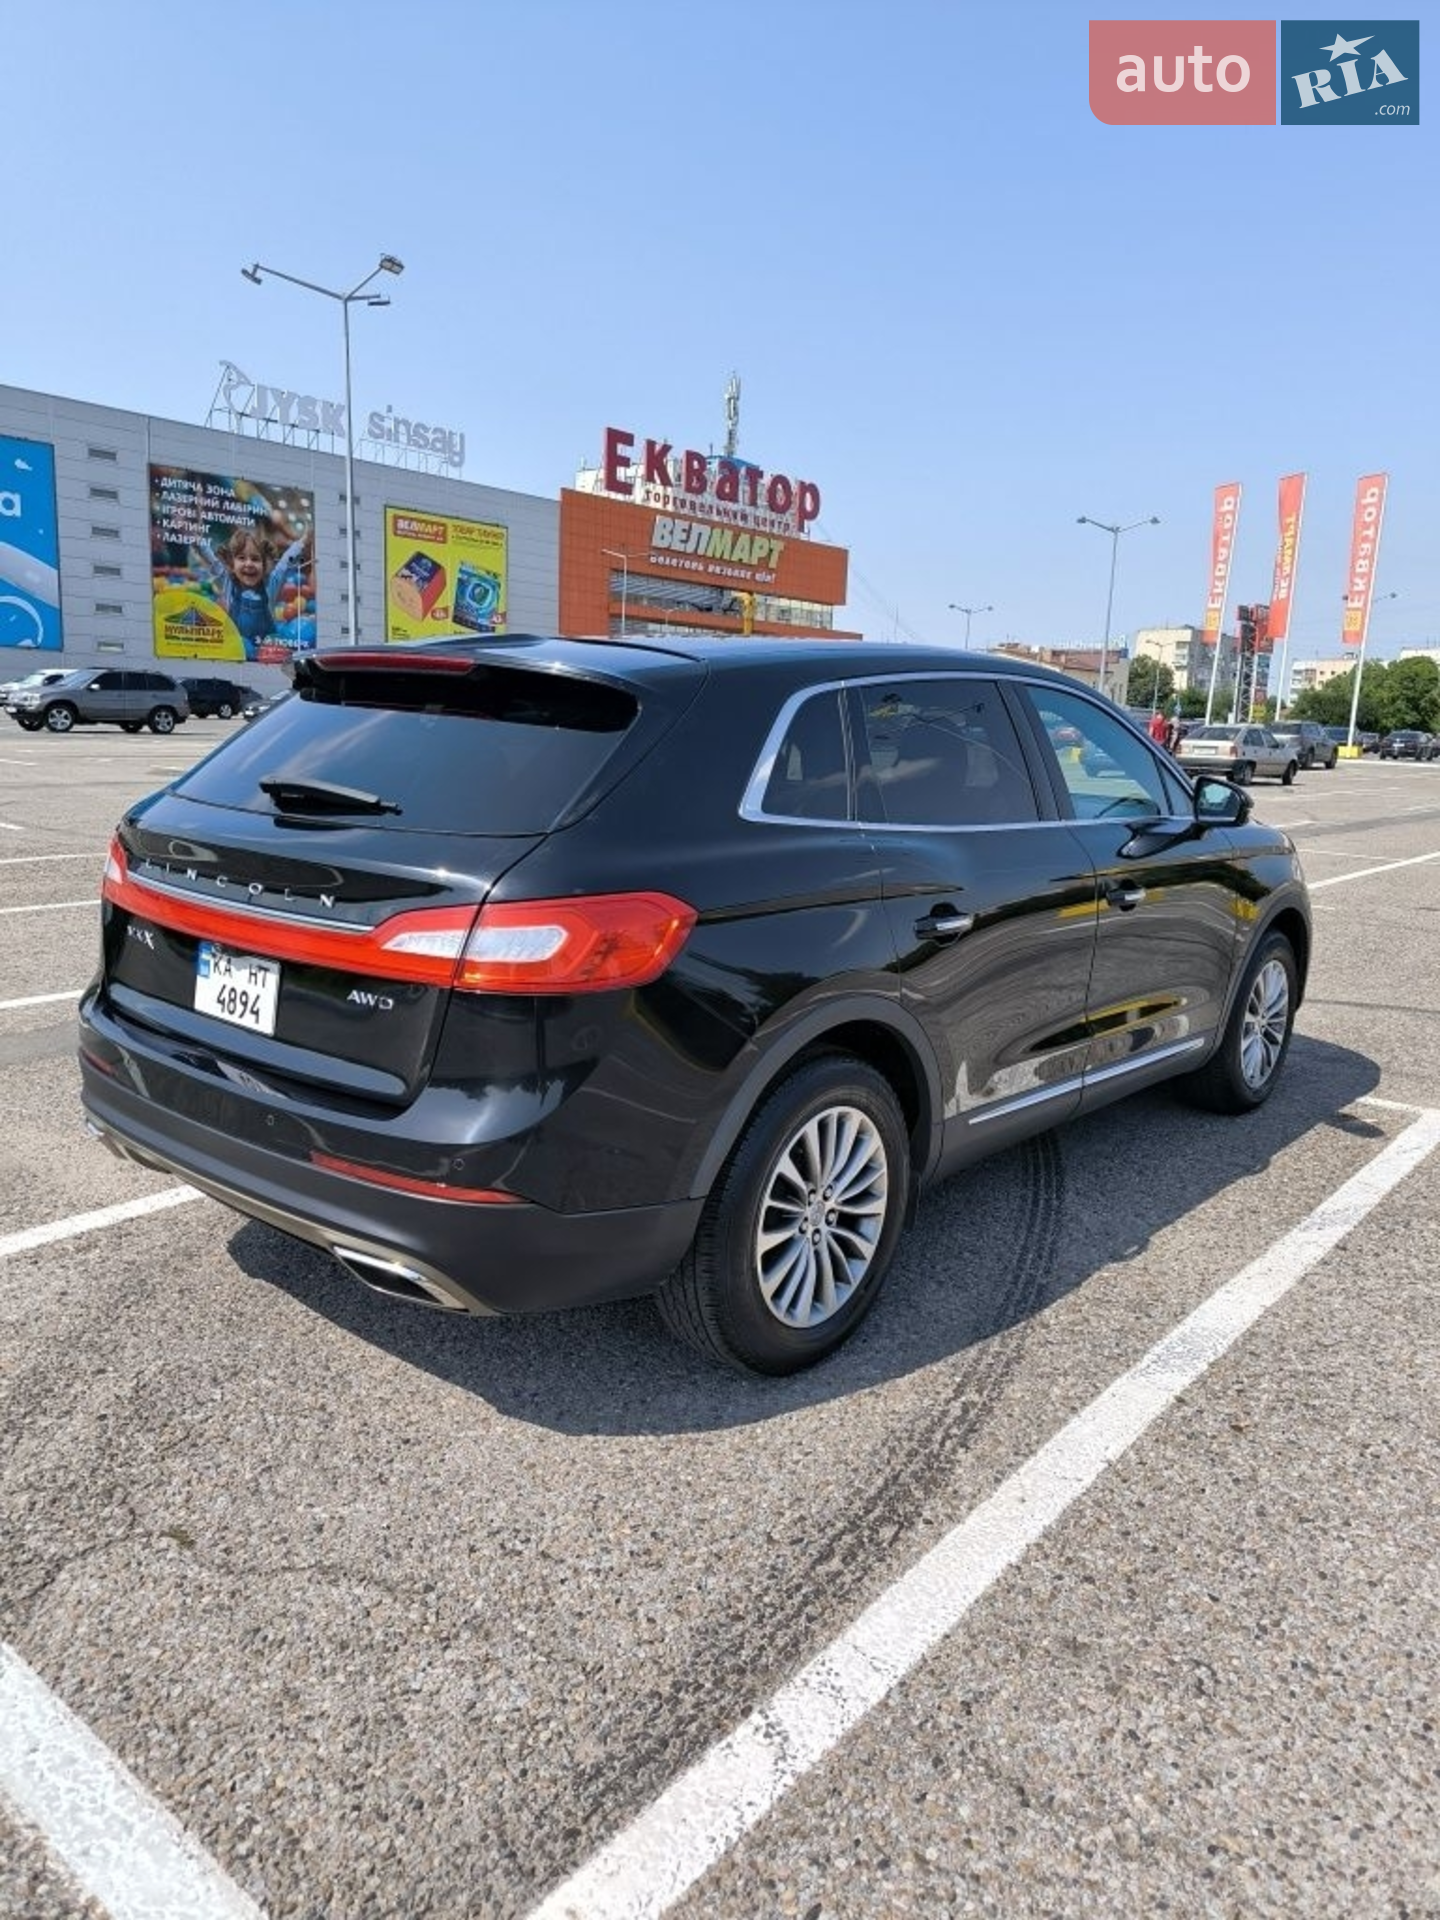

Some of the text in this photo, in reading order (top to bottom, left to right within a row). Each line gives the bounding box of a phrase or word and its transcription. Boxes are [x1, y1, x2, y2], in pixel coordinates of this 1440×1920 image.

[249, 383, 346, 438] JYSK
[367, 404, 466, 467] sinsay
[160, 477, 235, 498] ДИТЯЧА ЗОНА
[161, 491, 219, 509] ЛАЗЕРНИЙ
[162, 506, 256, 527] ІГРОВІ АВТОМАТИ
[162, 519, 211, 534] КАРТИНГ
[162, 532, 211, 547] ЛАЗЕРТАГ
[651, 515, 784, 569] ВЕЛМАРТ
[145, 859, 335, 908] LINCOLN
[216, 984, 260, 1024] 4894
[347, 989, 394, 1010] AWD
